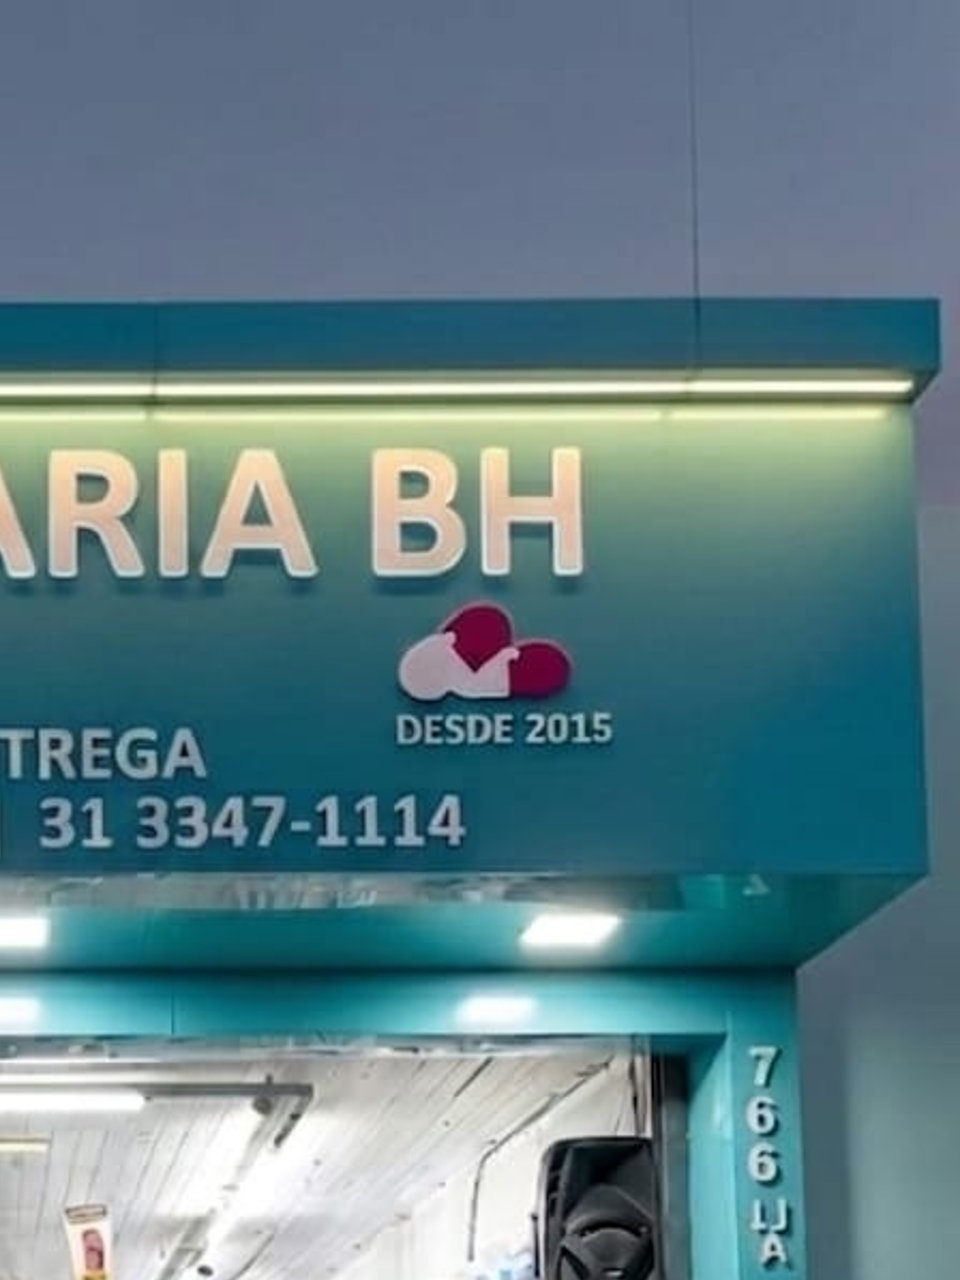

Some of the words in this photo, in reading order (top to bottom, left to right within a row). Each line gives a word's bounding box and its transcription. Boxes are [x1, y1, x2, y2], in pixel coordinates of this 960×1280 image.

[370, 446, 585, 579] BH
[395, 712, 514, 746] DESDE
[524, 711, 613, 745] 2015
[39, 797, 113, 849] 31
[135, 794, 466, 850] 3347-1114
[746, 1045, 780, 1184] 766
